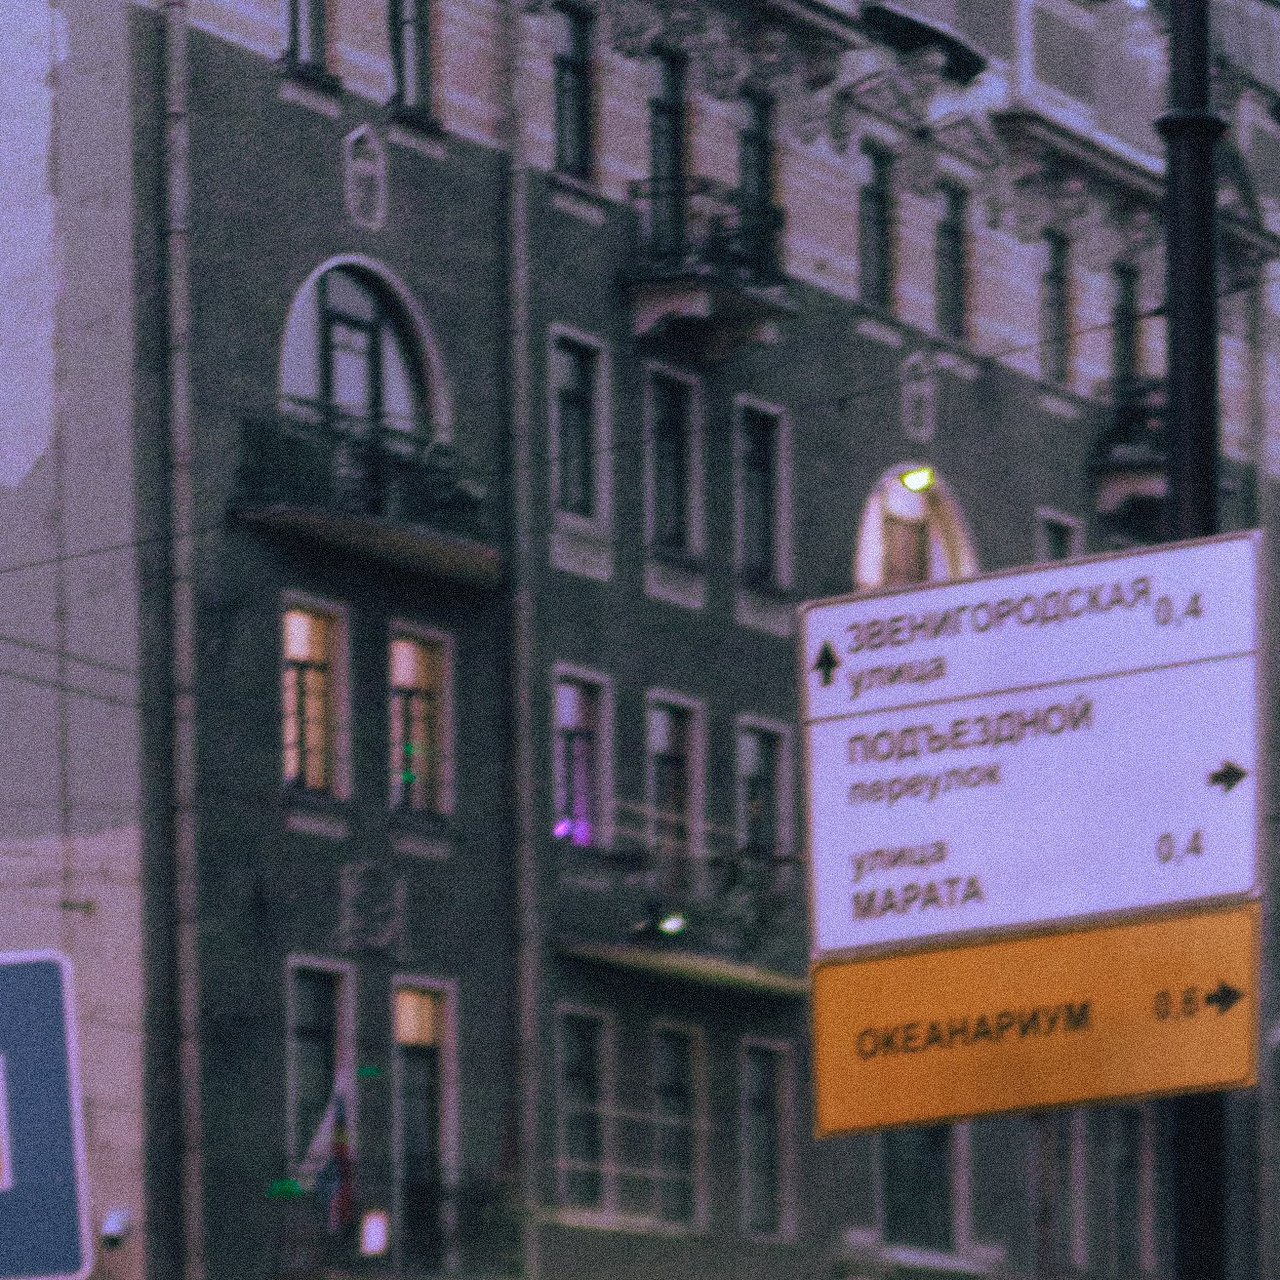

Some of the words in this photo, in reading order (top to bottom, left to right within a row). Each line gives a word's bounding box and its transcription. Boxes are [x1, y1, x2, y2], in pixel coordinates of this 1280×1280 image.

[846, 576, 1153, 653] ЗВЕНИГОРОДСКАЯ
[847, 656, 946, 700] улица
[848, 694, 1093, 764] ПОДЪЕЗДНОЙ
[848, 763, 1001, 806] переулок
[852, 839, 948, 883] улица
[852, 875, 985, 920] МАРАТА
[855, 999, 1092, 1060] ОКЕАНАРИУМ
